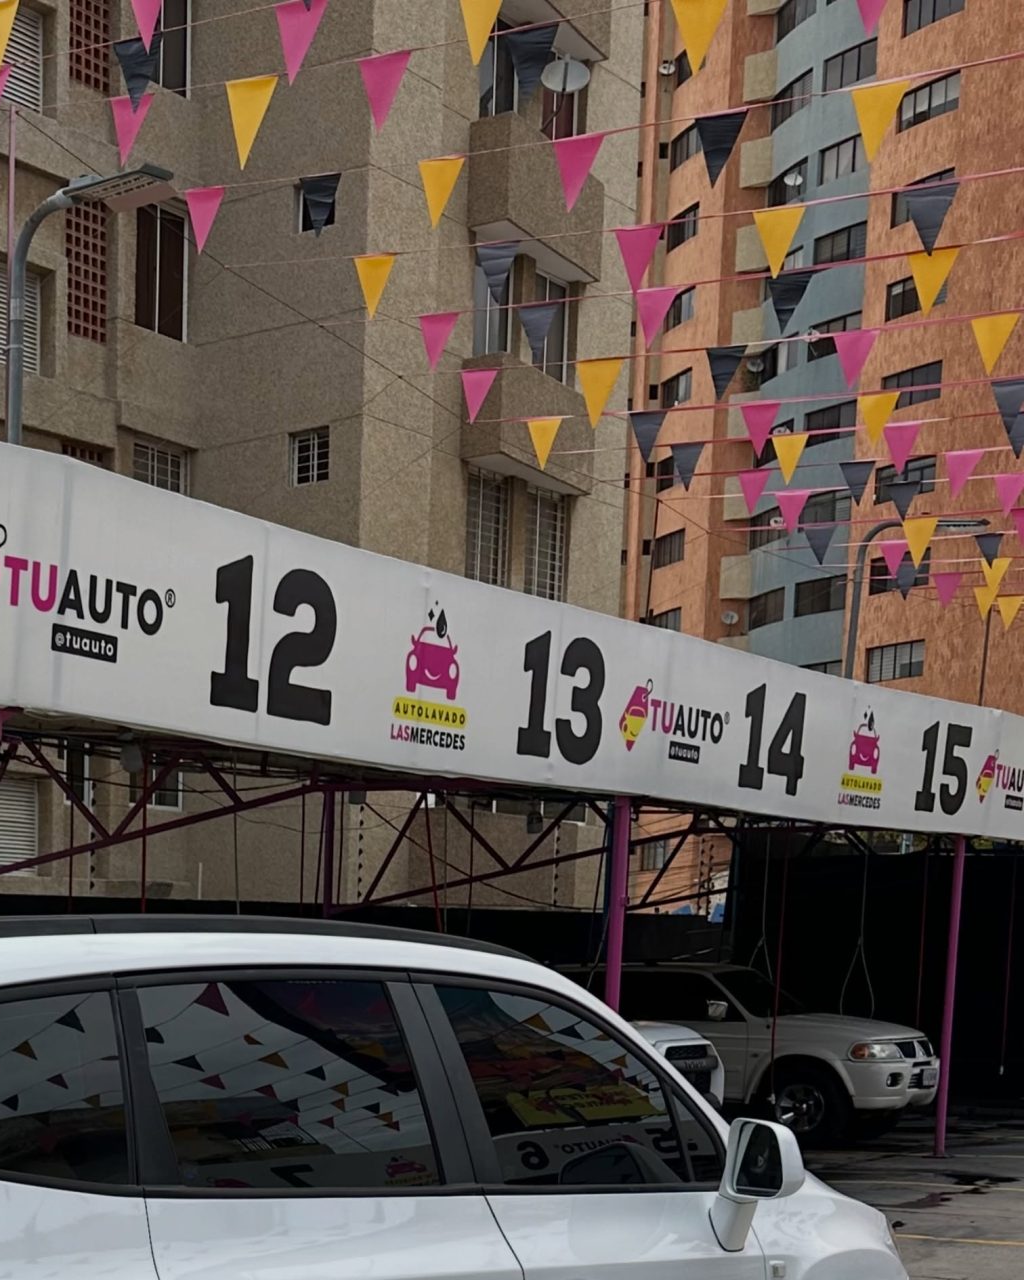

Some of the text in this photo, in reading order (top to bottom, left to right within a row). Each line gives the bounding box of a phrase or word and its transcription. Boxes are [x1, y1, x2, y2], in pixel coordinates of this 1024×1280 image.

[54, 631, 115, 657] @tuauto
[210, 554, 337, 726] 12
[394, 702, 466, 725] AUTOLAVADO
[516, 630, 606, 765] 13
[738, 683, 806, 796] 14
[841, 777, 882, 791] AUTOLAVADO
[914, 720, 973, 816] 15
